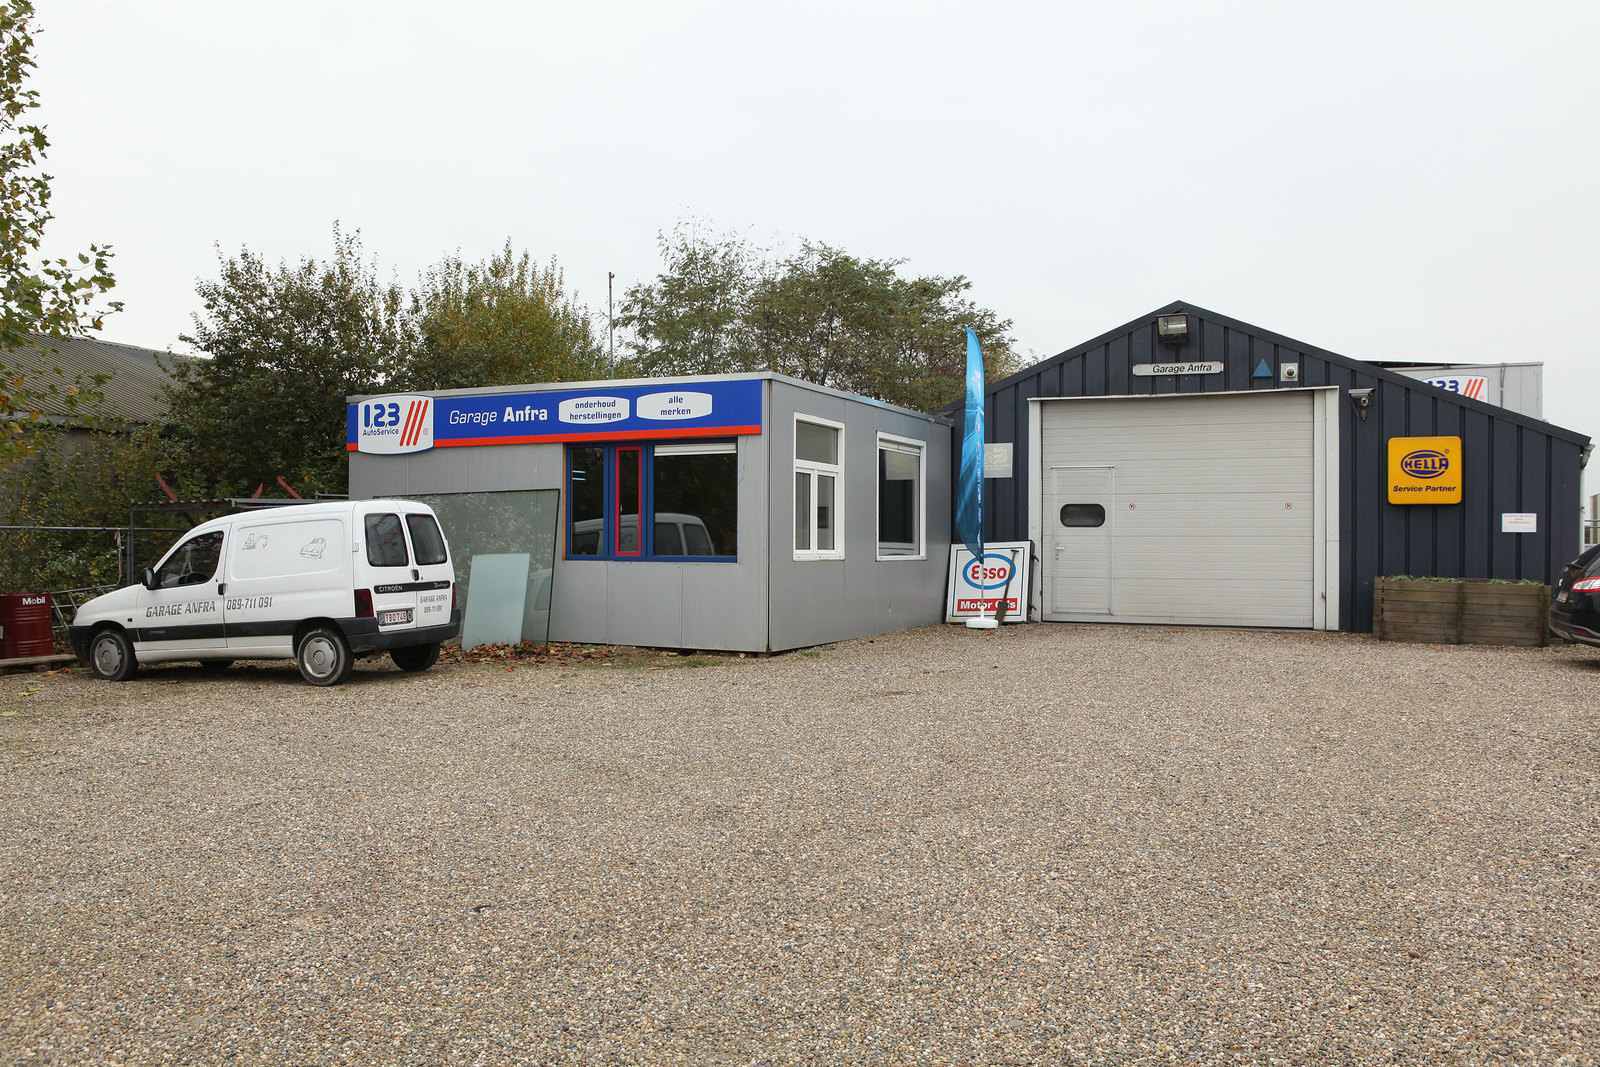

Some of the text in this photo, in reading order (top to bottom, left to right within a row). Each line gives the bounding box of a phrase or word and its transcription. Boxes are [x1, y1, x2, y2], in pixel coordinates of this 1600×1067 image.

[1152, 363, 1212, 374] Garage Anfra
[574, 399, 616, 410] onderhoud
[668, 395, 684, 404] alle
[449, 405, 548, 426] Garage Anfra
[569, 411, 622, 421] herstellingen
[660, 407, 692, 416] merken
[362, 427, 400, 437] AutoService
[1404, 457, 1449, 470] HELLA
[22, 596, 46, 605] Mobil
[960, 600, 993, 610] Motor
[145, 596, 273, 618] GARAGE ANFRA 089-711 091
